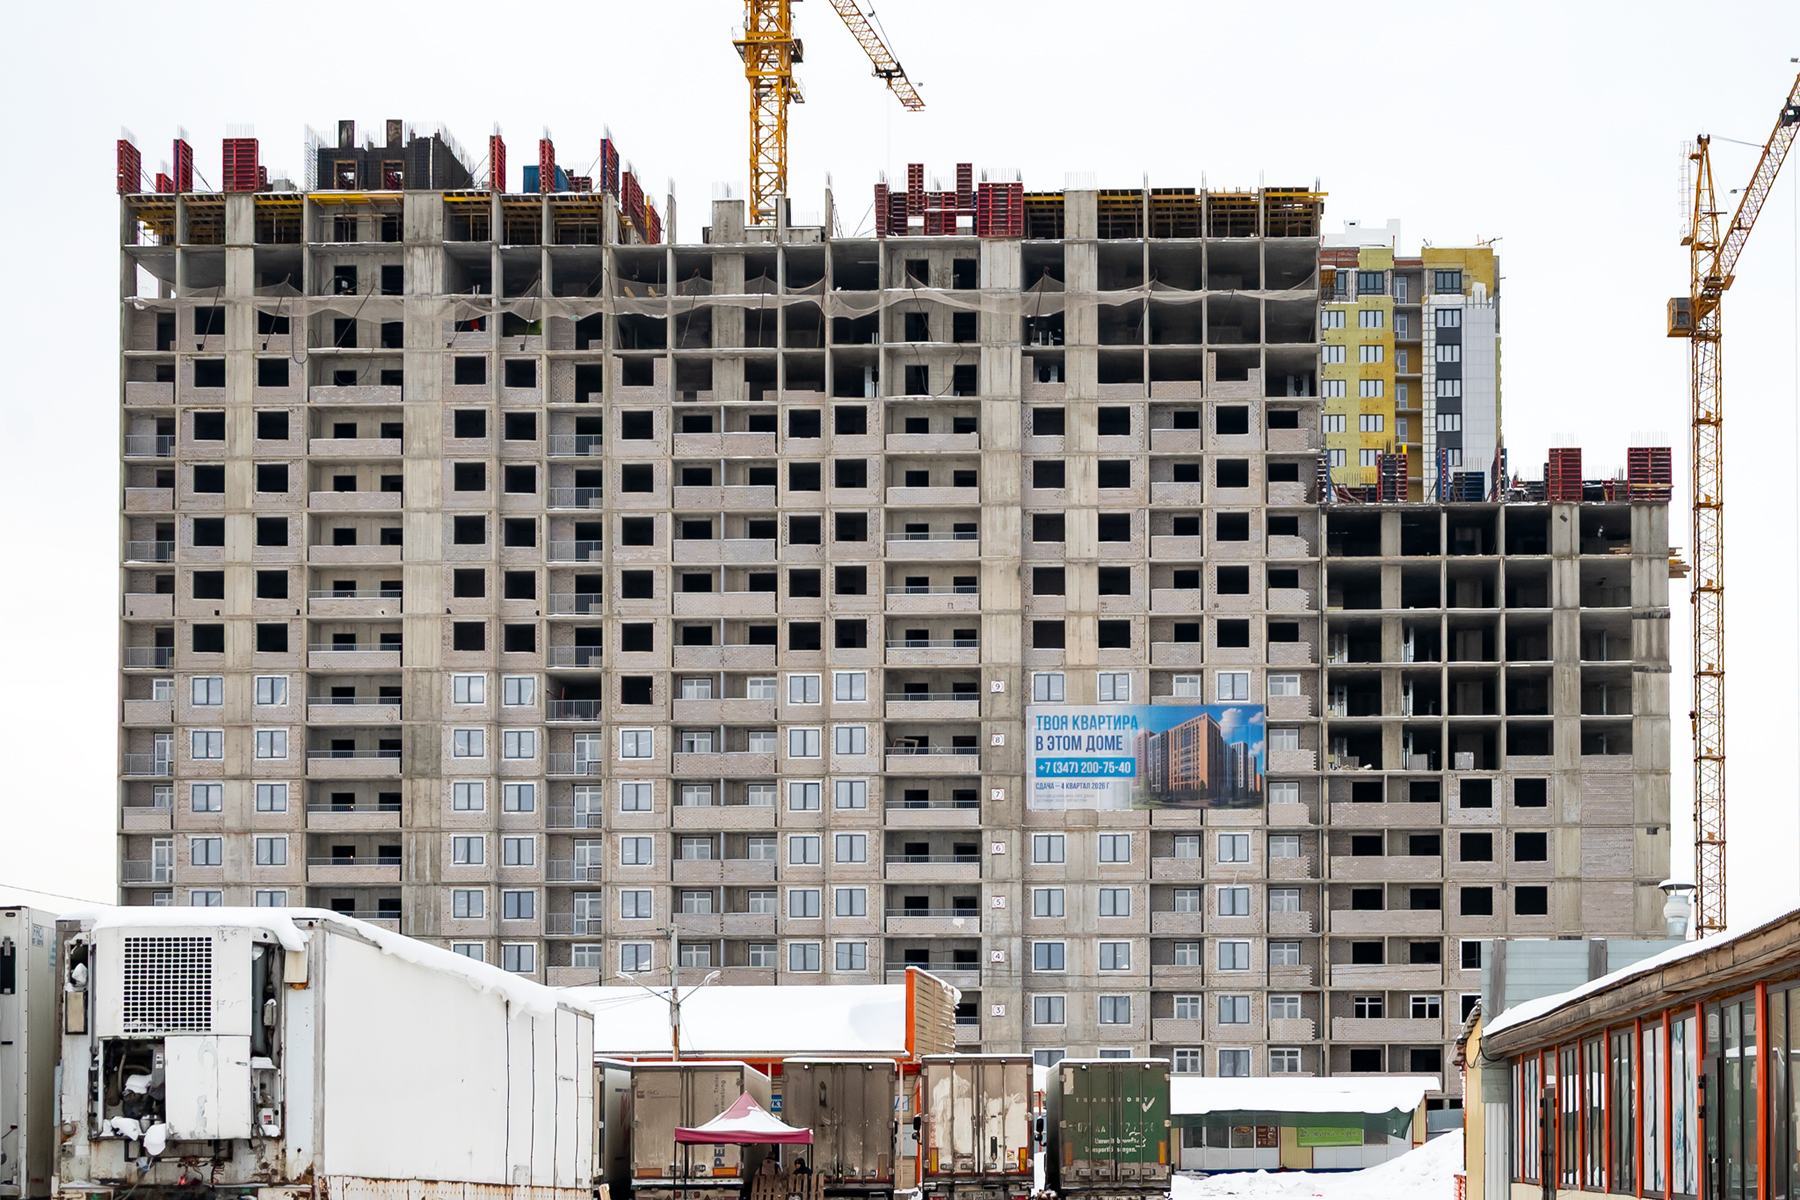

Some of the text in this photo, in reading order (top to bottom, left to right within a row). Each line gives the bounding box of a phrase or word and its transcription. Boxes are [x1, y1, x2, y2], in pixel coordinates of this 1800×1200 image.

[1036, 715, 1138, 731] ТВОЯ КВАРТИРА
[1036, 735, 1123, 752] В ЭТОМ ДОМЕ
[1039, 762, 1131, 774] +7 (347) 200-75-40
[1036, 782, 1055, 790] СДАЧА
[1066, 782, 1090, 790] КВАРТАЛ
[1092, 782, 1105, 790] 2026
